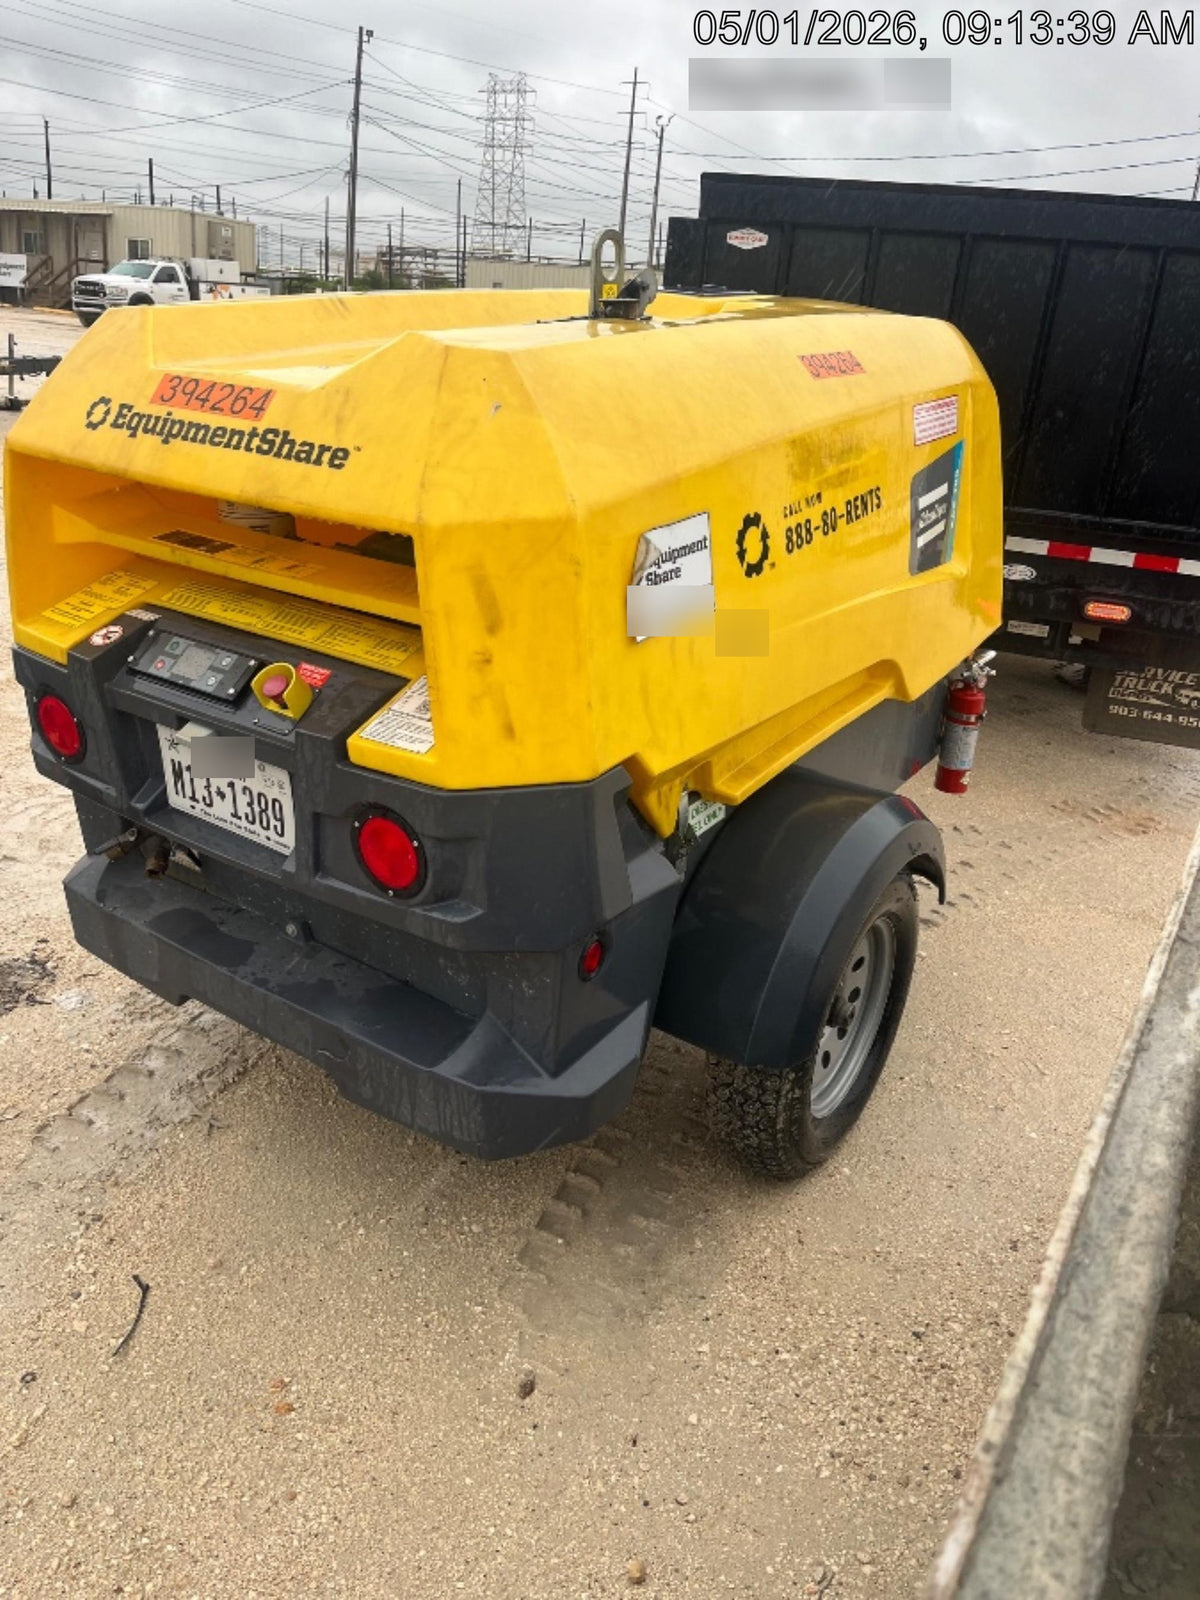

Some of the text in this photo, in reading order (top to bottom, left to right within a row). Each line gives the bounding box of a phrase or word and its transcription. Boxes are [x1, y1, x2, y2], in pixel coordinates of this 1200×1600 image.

[159, 374, 273, 419] 394264
[110, 402, 351, 470] EquipmentShare
[784, 485, 882, 555] 888-80-RENTS
[650, 534, 709, 570] quipment
